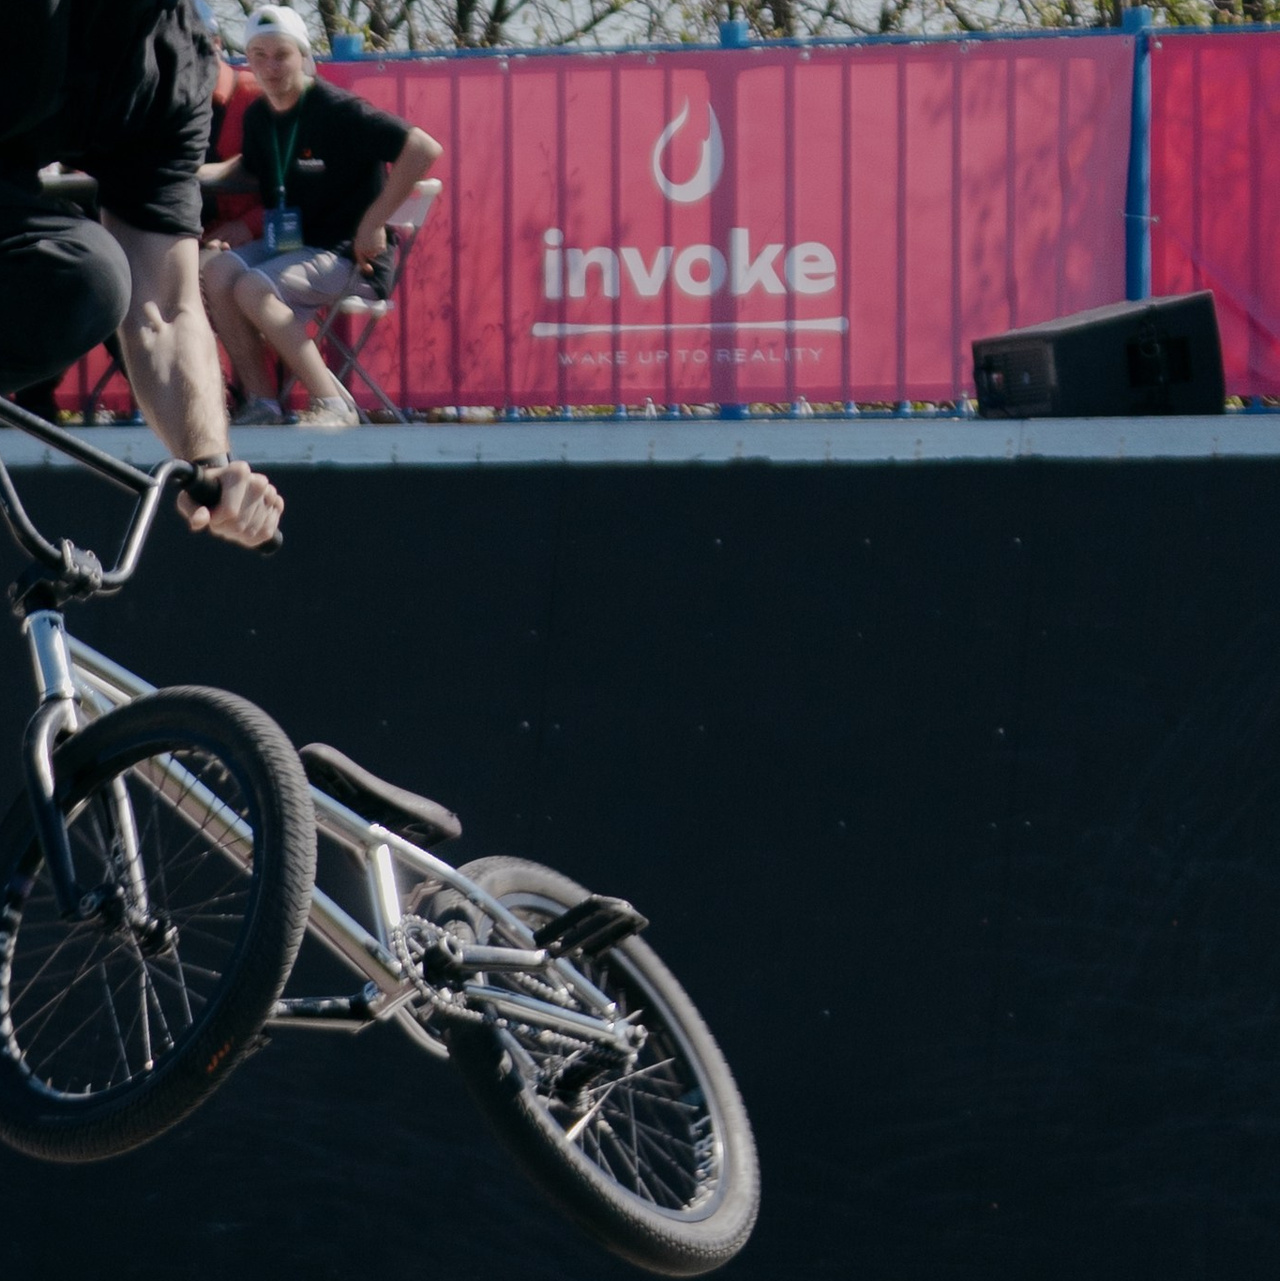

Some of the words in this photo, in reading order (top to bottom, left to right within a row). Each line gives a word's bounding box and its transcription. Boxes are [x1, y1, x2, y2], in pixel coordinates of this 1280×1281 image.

[544, 227, 837, 300] invoke
[559, 349, 629, 365] WAKE
[638, 349, 670, 365] UP
[677, 348, 709, 364] TO
[715, 347, 823, 364] REALITY
